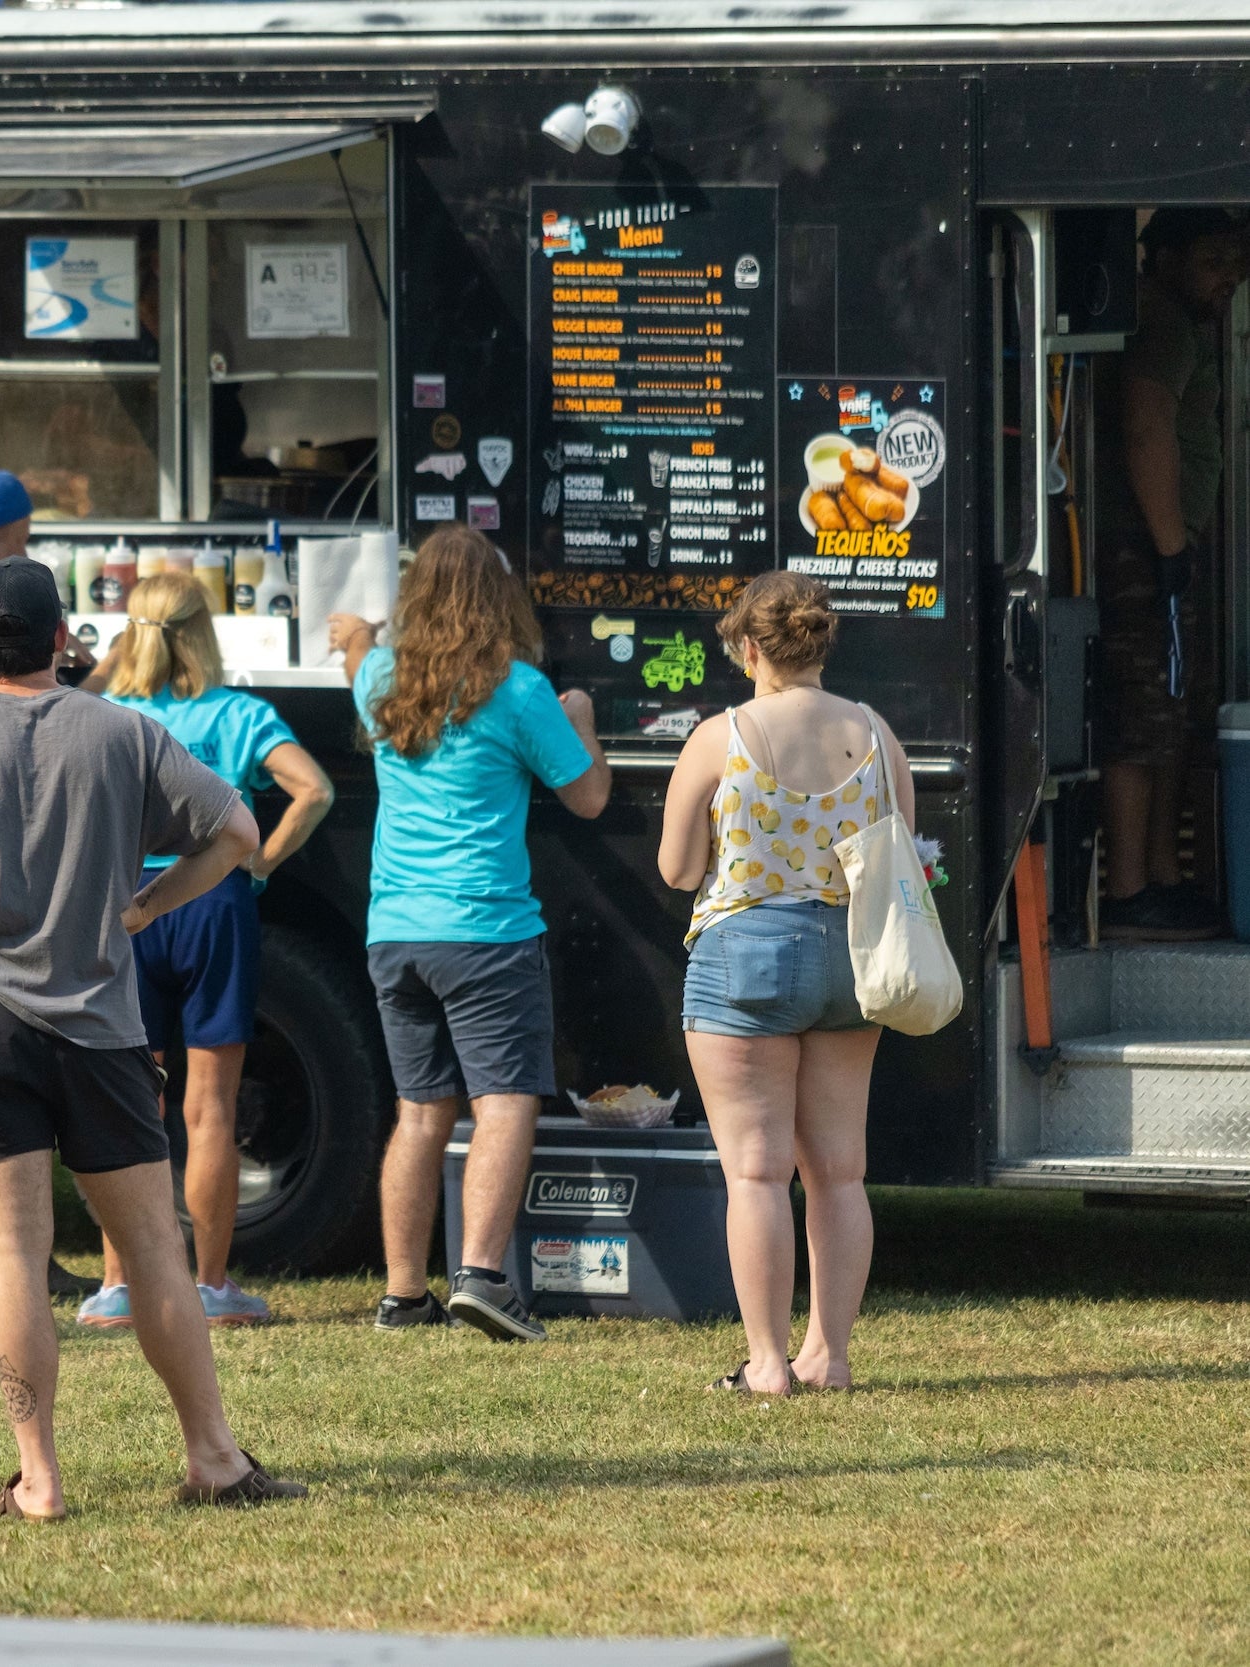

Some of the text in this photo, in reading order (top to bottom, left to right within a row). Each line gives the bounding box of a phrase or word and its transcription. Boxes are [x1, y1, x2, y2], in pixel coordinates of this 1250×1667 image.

[599, 203, 676, 230] FOOD TRUCK
[619, 226, 663, 249] Menu
[261, 263, 276, 284] A
[552, 261, 586, 276] CHEESE
[586, 262, 623, 277] BURGER
[582, 288, 619, 303] BURGER
[552, 318, 586, 333] VEGGIE
[586, 319, 623, 334] BURGER
[552, 347, 582, 361] HOUSE
[583, 347, 620, 362] BURGER
[552, 373, 578, 387] VANE
[578, 373, 616, 388] BURGER
[552, 397, 585, 412] ALOHA
[585, 398, 623, 413] BURGER
[839, 396, 871, 414] VANE
[563, 443, 594, 457] WINGS
[691, 441, 715, 456] SIDES
[887, 430, 934, 459] NEW
[670, 457, 707, 472] FRENCH
[708, 457, 732, 473] FRIES
[890, 452, 935, 469] PRODUCT
[563, 474, 604, 488] CHICKEN
[670, 474, 708, 489] ARANZA
[709, 475, 733, 490] FRIES
[564, 489, 603, 502] TENDERS
[670, 499, 712, 515] BUFFALO
[713, 500, 737, 515] FRIES
[670, 525, 702, 540] ONION
[702, 525, 730, 540] RINGS
[815, 524, 911, 557] TEQUEÑOS
[670, 547, 703, 563] DRINKS
[786, 555, 938, 578] VENEZUELAN CHEESE STICKS
[828, 578, 846, 590] and
[846, 578, 880, 591] cilantro
[881, 582, 907, 591] sauce
[906, 583, 938, 611] $10
[538, 1179, 609, 1201] Coleman
